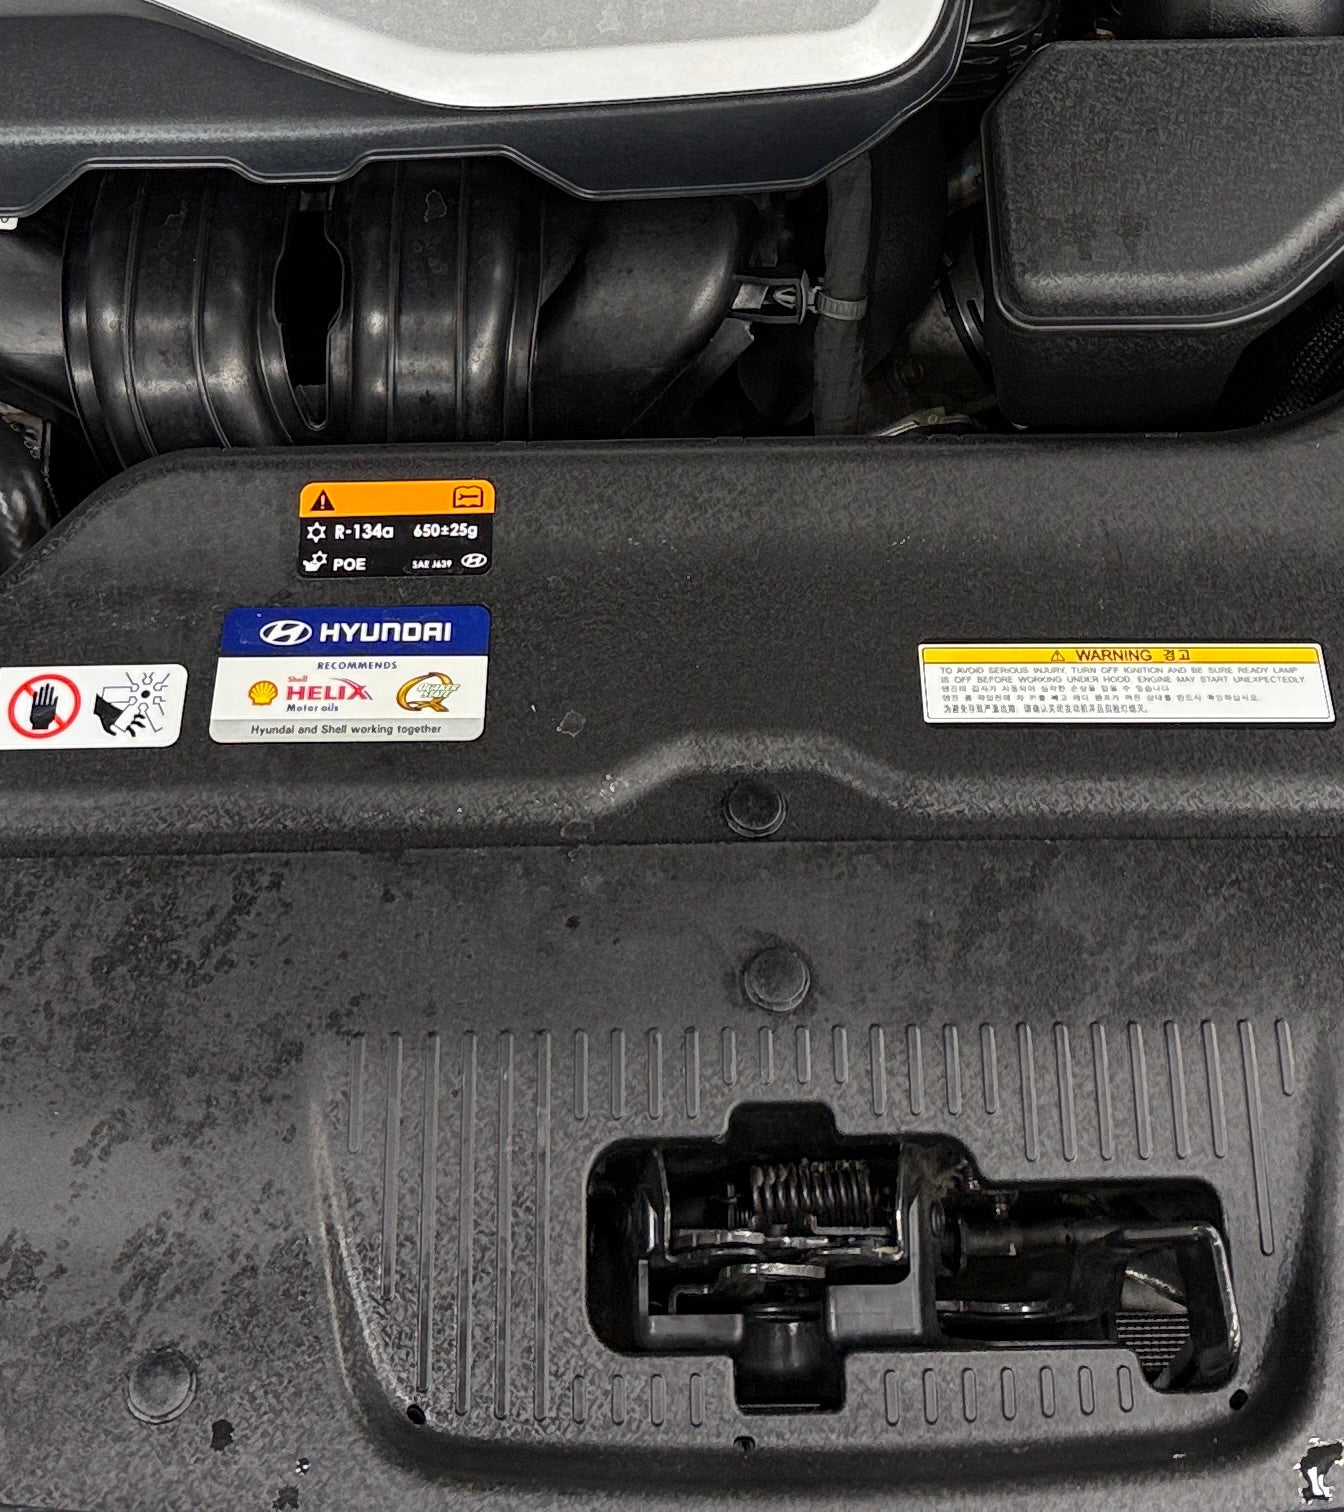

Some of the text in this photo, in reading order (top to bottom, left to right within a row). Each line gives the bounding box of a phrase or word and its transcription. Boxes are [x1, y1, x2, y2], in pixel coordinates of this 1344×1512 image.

[335, 523, 478, 539] R-134a 650±25g
[333, 558, 453, 571] POE SAE J639
[319, 622, 452, 642] HYUNDAI
[1076, 650, 1152, 662] WARNING
[317, 661, 398, 670] RECOMMENDS
[287, 675, 308, 683] Shell
[286, 679, 373, 700] HELIX
[286, 704, 339, 712] Motor oils
[251, 724, 442, 736] Hyundai and Shell working together
